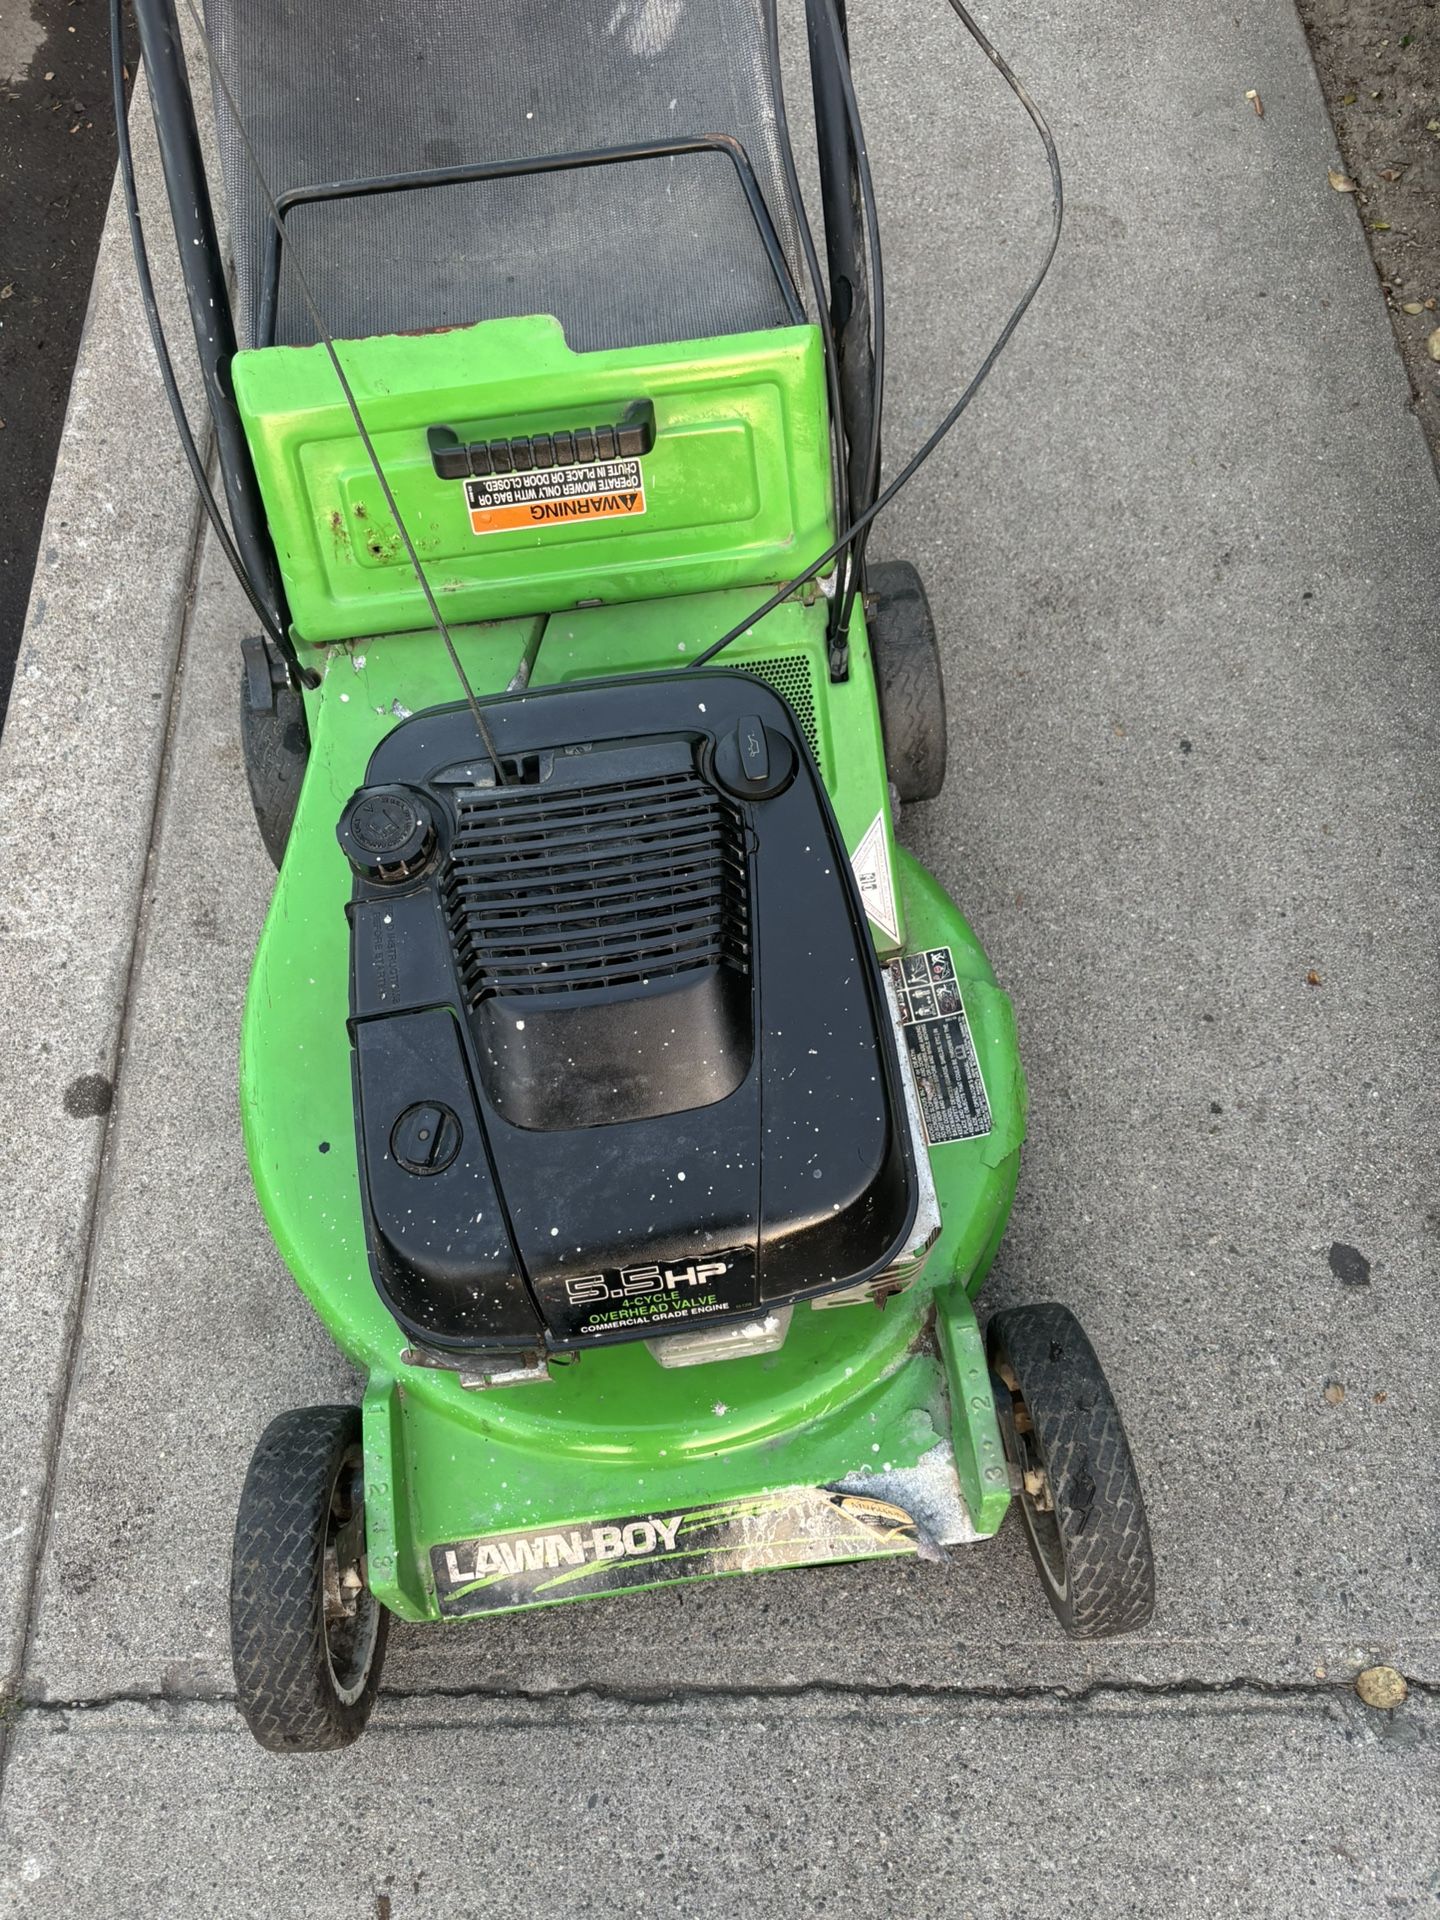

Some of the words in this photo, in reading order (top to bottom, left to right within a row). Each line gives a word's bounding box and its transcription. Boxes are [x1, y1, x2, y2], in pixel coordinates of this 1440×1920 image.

[567, 468, 595, 482] PLACE
[597, 467, 606, 477] IN
[608, 462, 637, 477] CHUTE
[483, 477, 522, 491] CLOSED.
[523, 474, 551, 487] DOOR
[551, 472, 565, 483] OR
[599, 475, 639, 491] OPERATE
[514, 487, 538, 501] WITH
[538, 483, 562, 498] ONLY
[563, 479, 597, 495] MOWER
[478, 494, 493, 507] OR
[494, 491, 513, 504] BAG
[530, 493, 620, 520] WARNING
[565, 1262, 727, 1305] 5.5HP
[622, 1290, 680, 1307] 4-CYCLE
[589, 1303, 668, 1324] OVERHEAD
[672, 1294, 717, 1310] VALVE
[580, 1317, 650, 1333] COMMERCIAL
[652, 1310, 688, 1321] GRADE
[691, 1302, 730, 1315] ENGINE
[970, 1395, 992, 1413] 2
[984, 1467, 1004, 1482] 3
[368, 1481, 390, 1497] 2
[445, 1517, 684, 1585] LAWN-BOY
